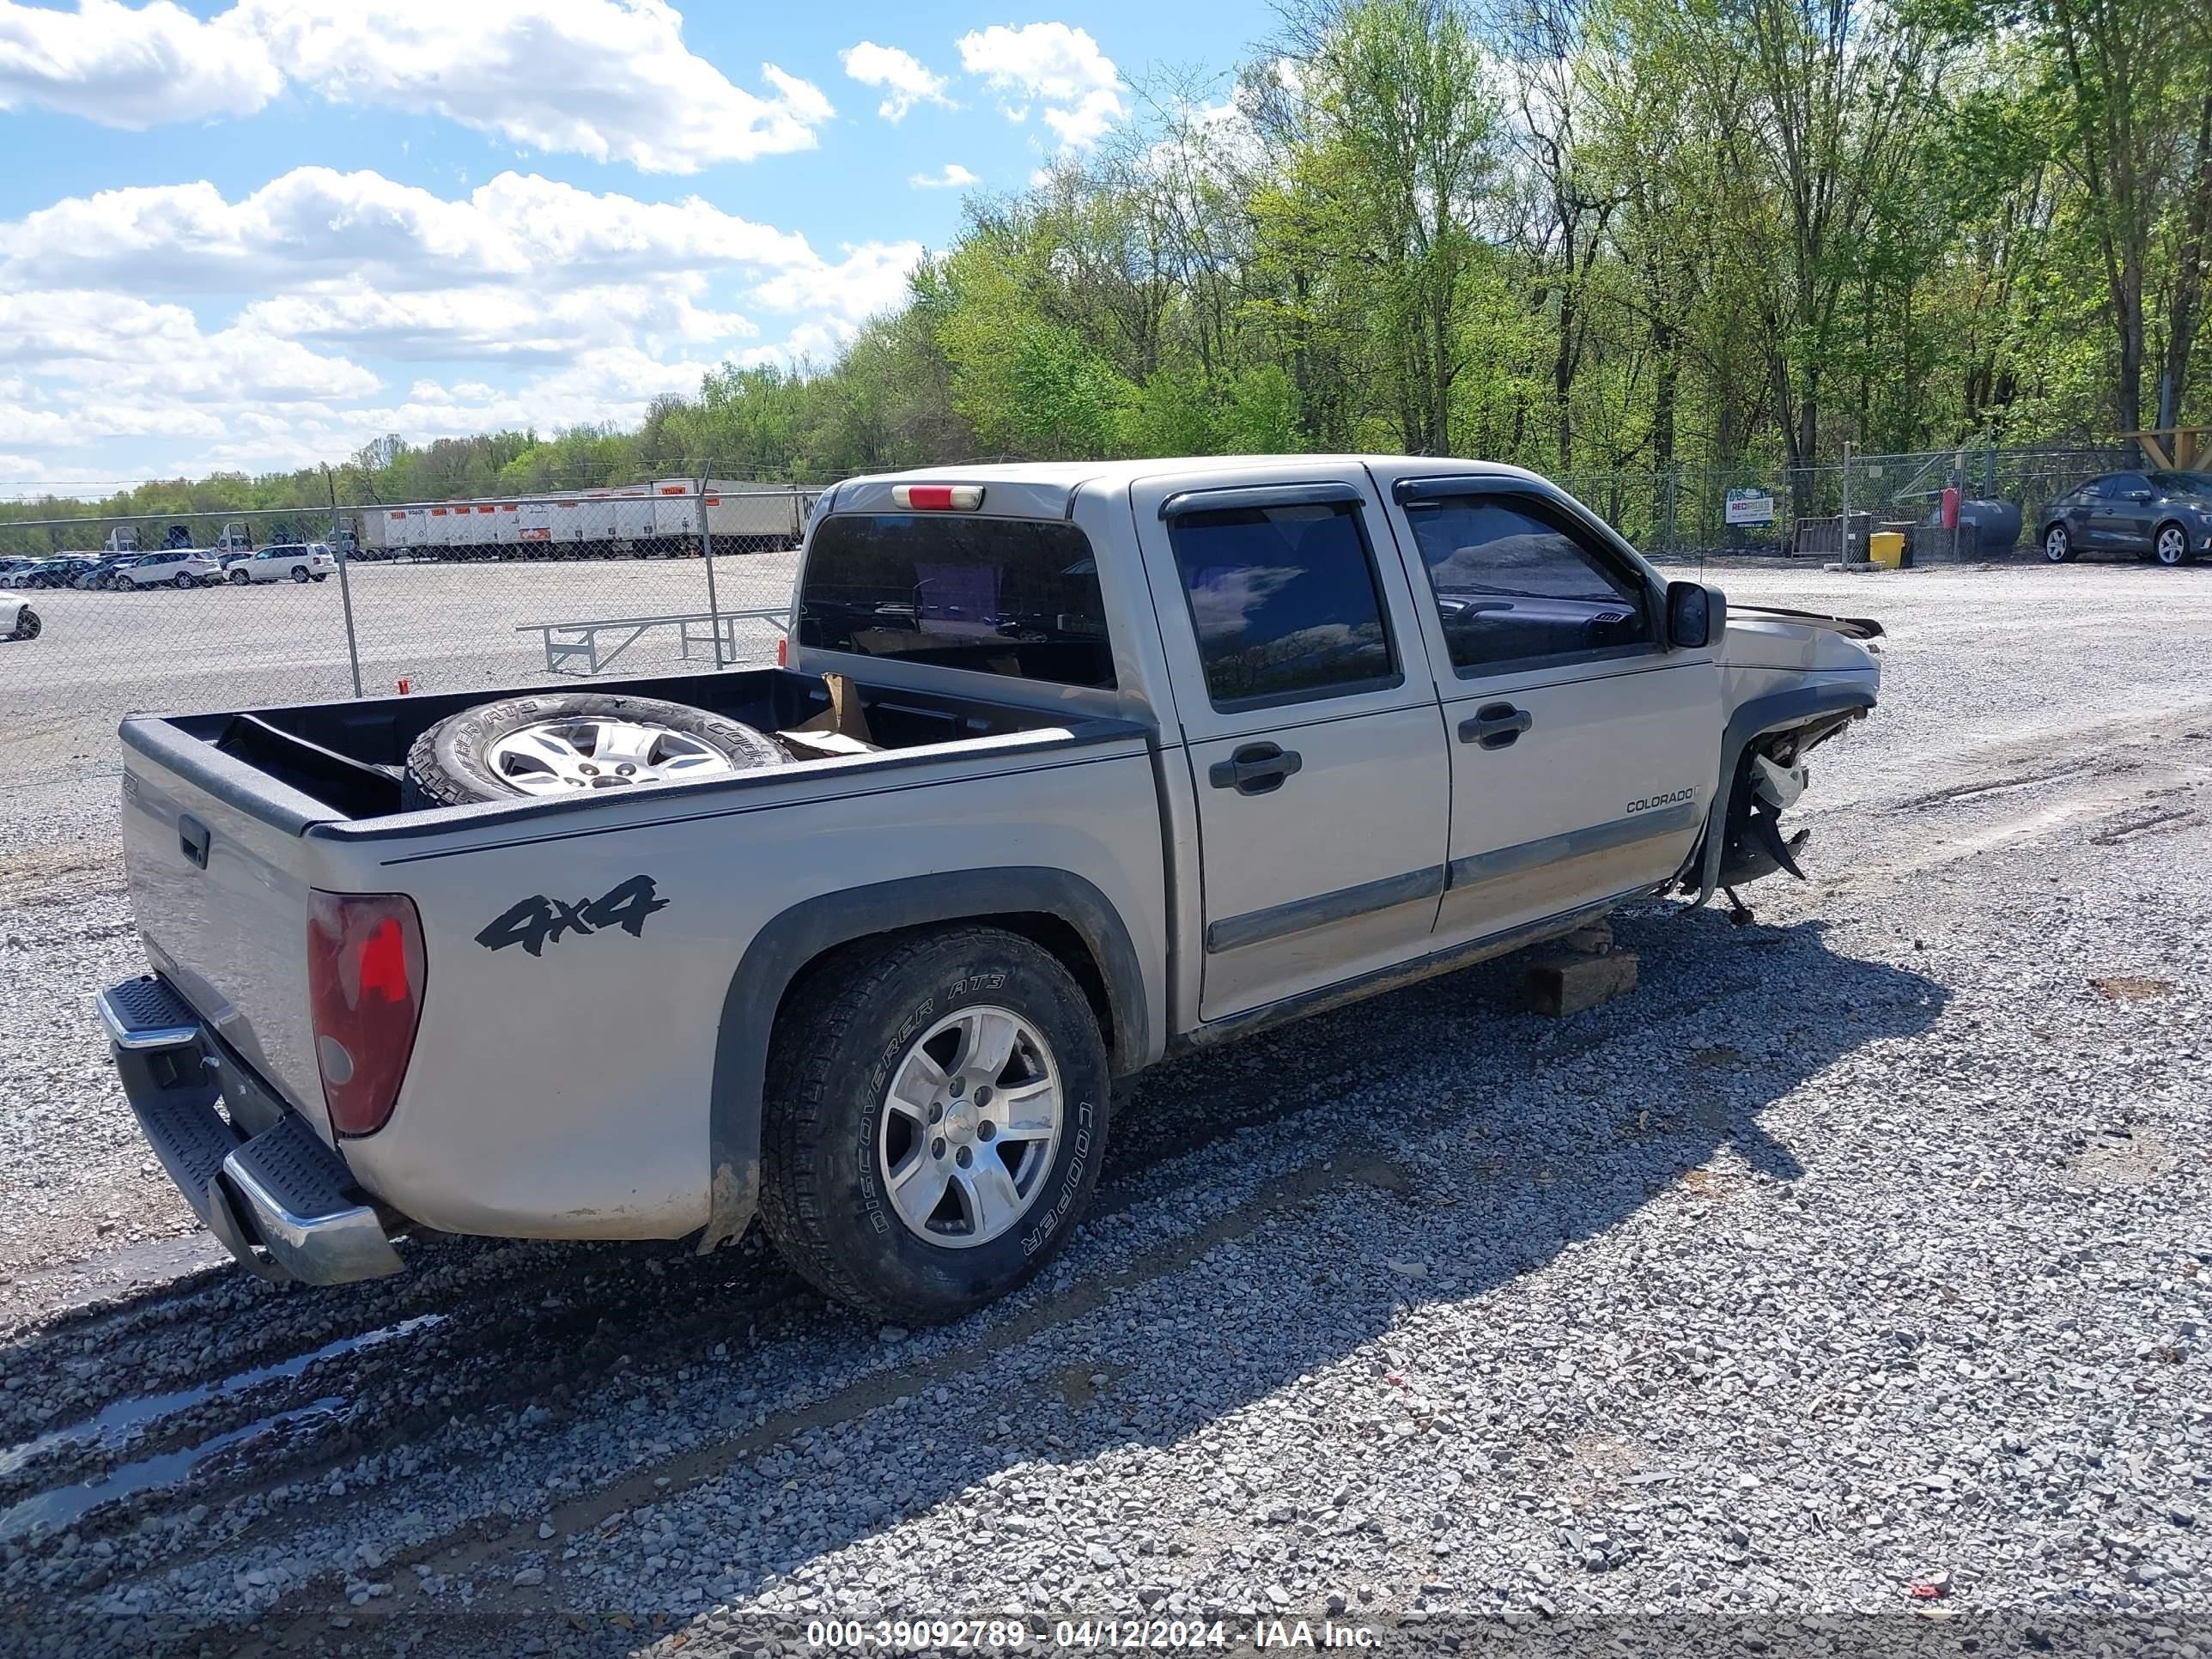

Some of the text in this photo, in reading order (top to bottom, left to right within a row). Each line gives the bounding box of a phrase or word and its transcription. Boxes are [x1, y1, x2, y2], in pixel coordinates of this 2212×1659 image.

[483, 701, 538, 726] AT3
[706, 722, 766, 768] COOP
[1626, 787, 1693, 813] COLORADO
[857, 973, 1006, 1236] DISCOVERER AT3
[1021, 1101, 1094, 1257] COOPER
